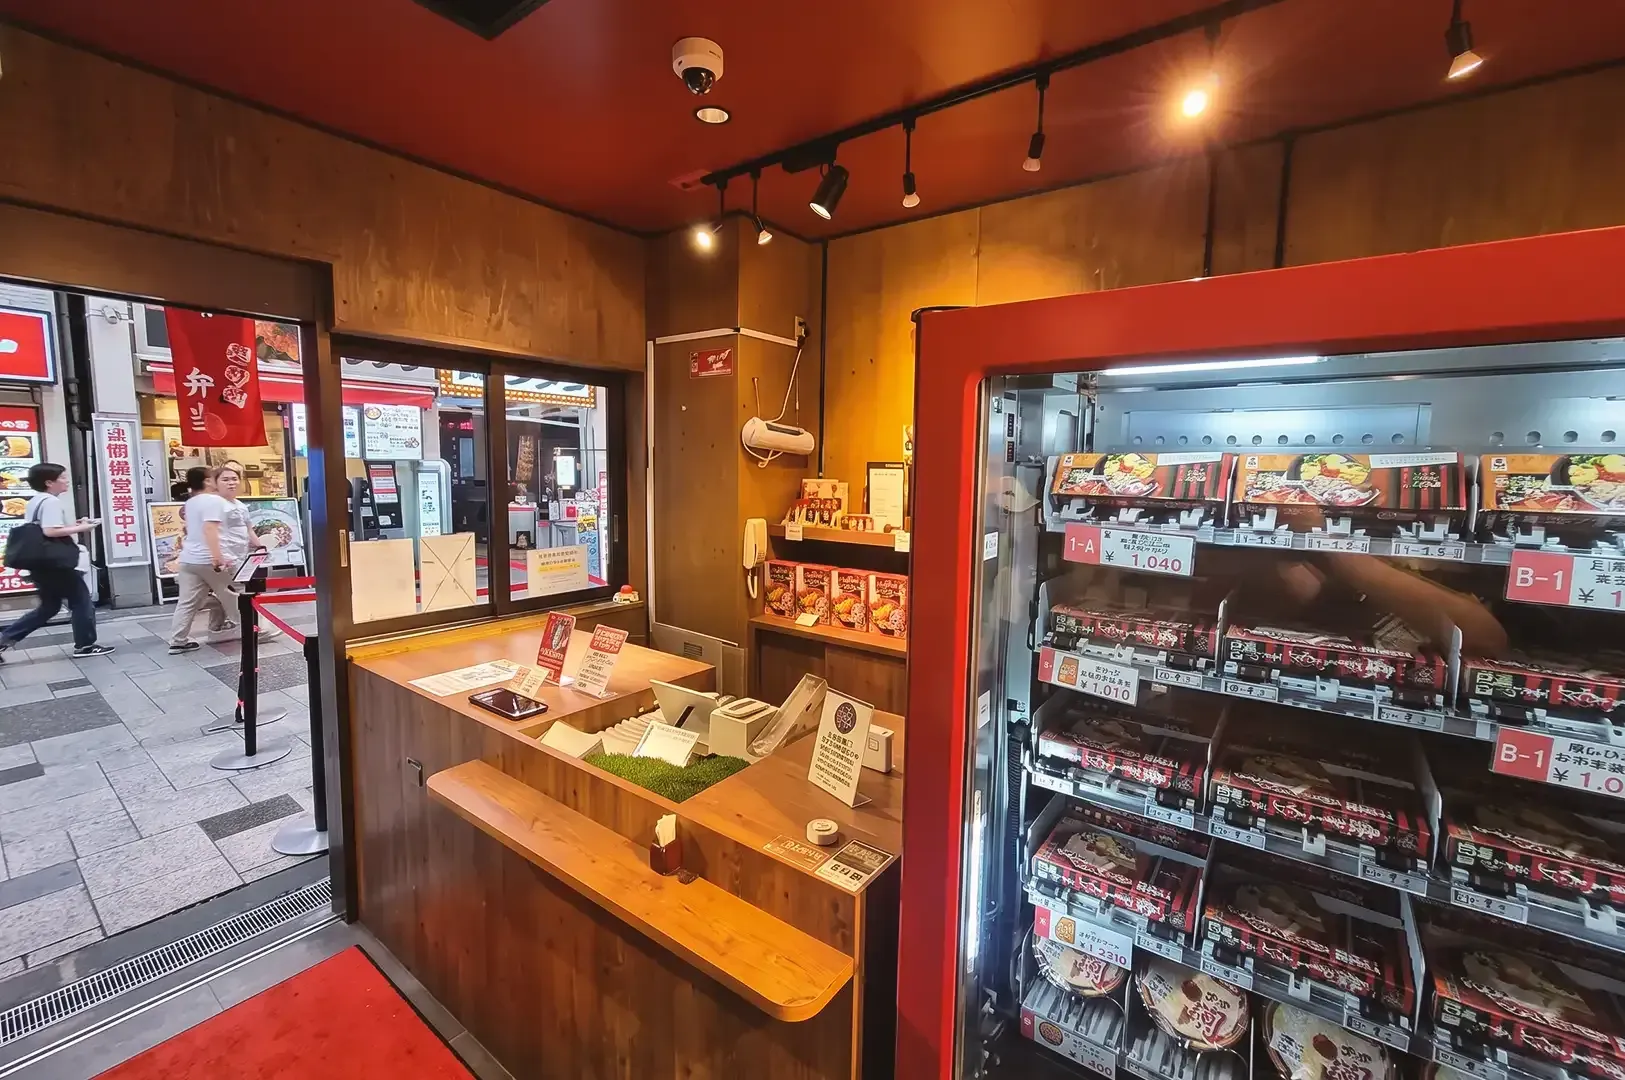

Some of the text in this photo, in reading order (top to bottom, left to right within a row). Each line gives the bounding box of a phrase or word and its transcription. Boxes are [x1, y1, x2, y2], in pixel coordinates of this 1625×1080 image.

[1069, 537, 1095, 554] 1-A
[1515, 567, 1564, 591] B-1
[1500, 743, 1545, 769] B-1
